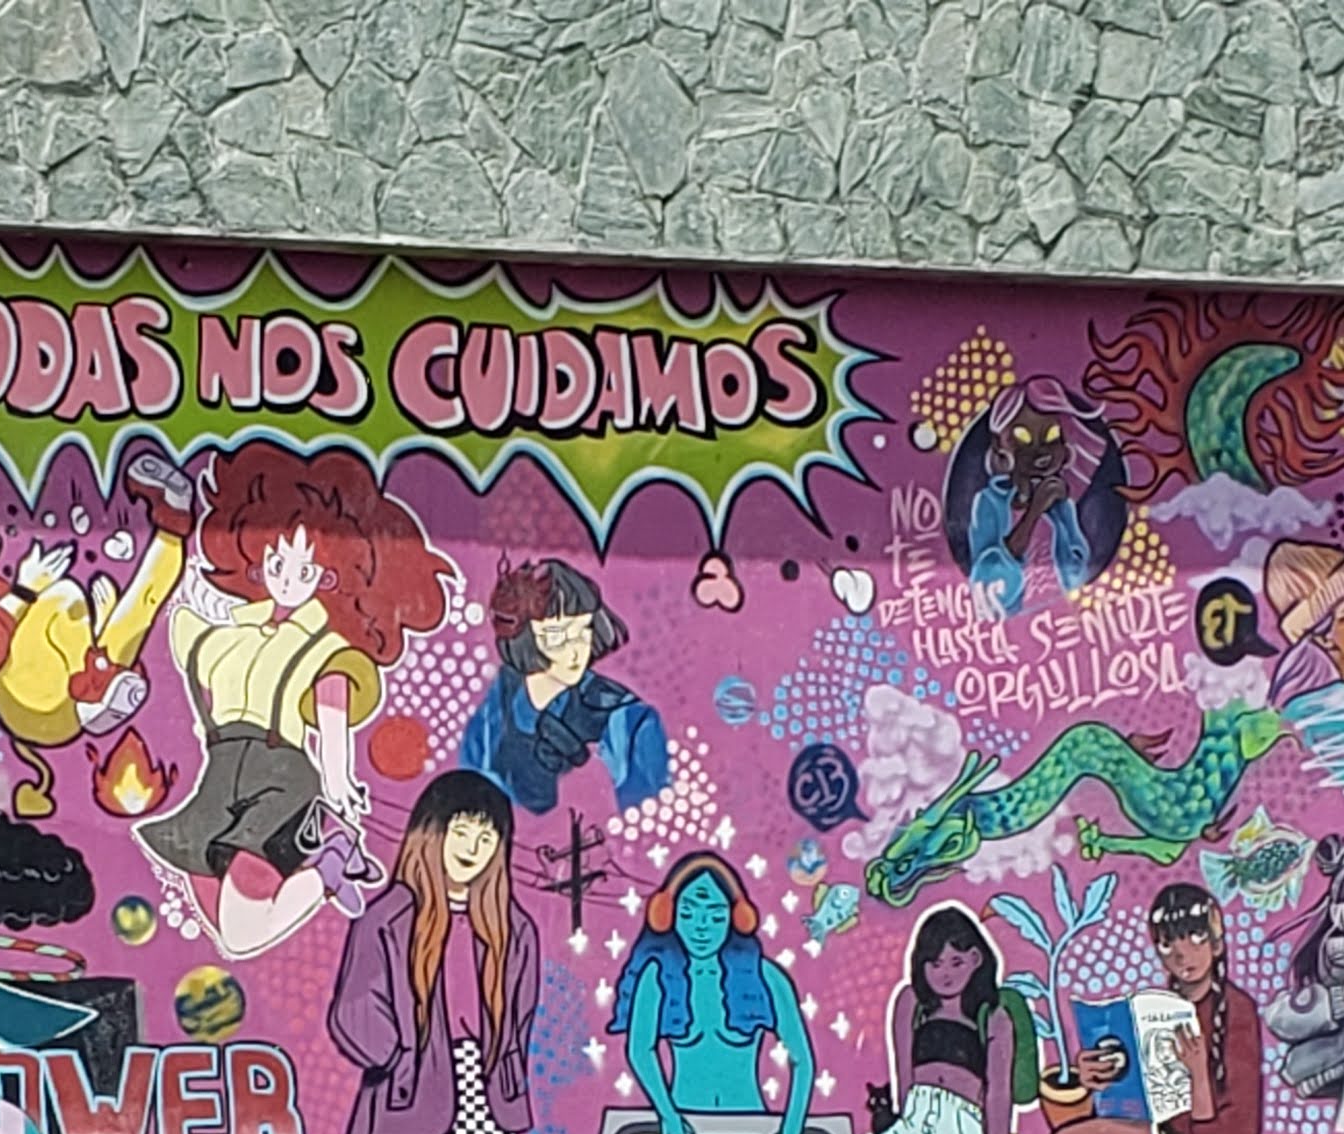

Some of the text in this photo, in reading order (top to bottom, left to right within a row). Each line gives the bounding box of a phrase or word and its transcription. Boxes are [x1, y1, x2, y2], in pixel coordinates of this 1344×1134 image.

[197, 311, 374, 422] NOS
[389, 314, 826, 440] CUIDAMOS
[890, 485, 943, 543] NO
[955, 642, 1188, 726] ORGULLOSA
